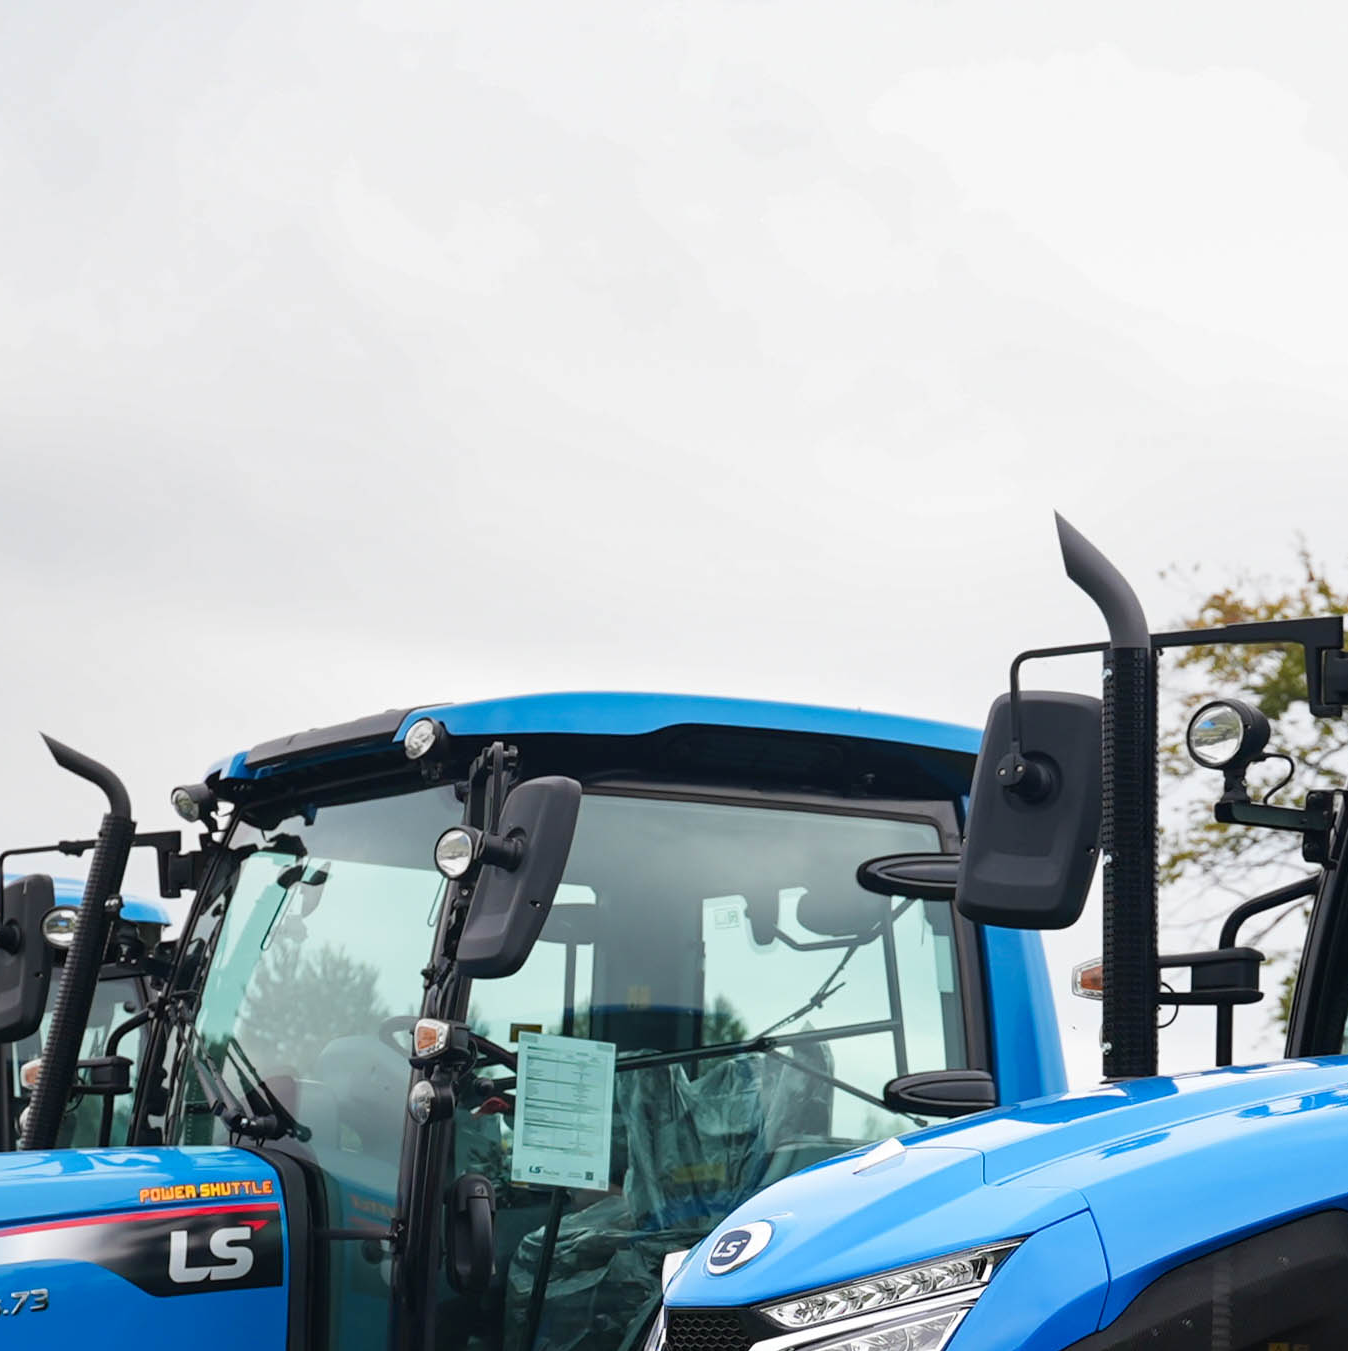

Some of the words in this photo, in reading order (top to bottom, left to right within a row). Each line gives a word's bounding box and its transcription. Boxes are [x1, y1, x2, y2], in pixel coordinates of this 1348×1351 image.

[139, 1185, 197, 1203] POWER
[200, 1180, 274, 1198] SHUTTLE
[168, 1226, 254, 1284] LS
[712, 1240, 743, 1258] LS
